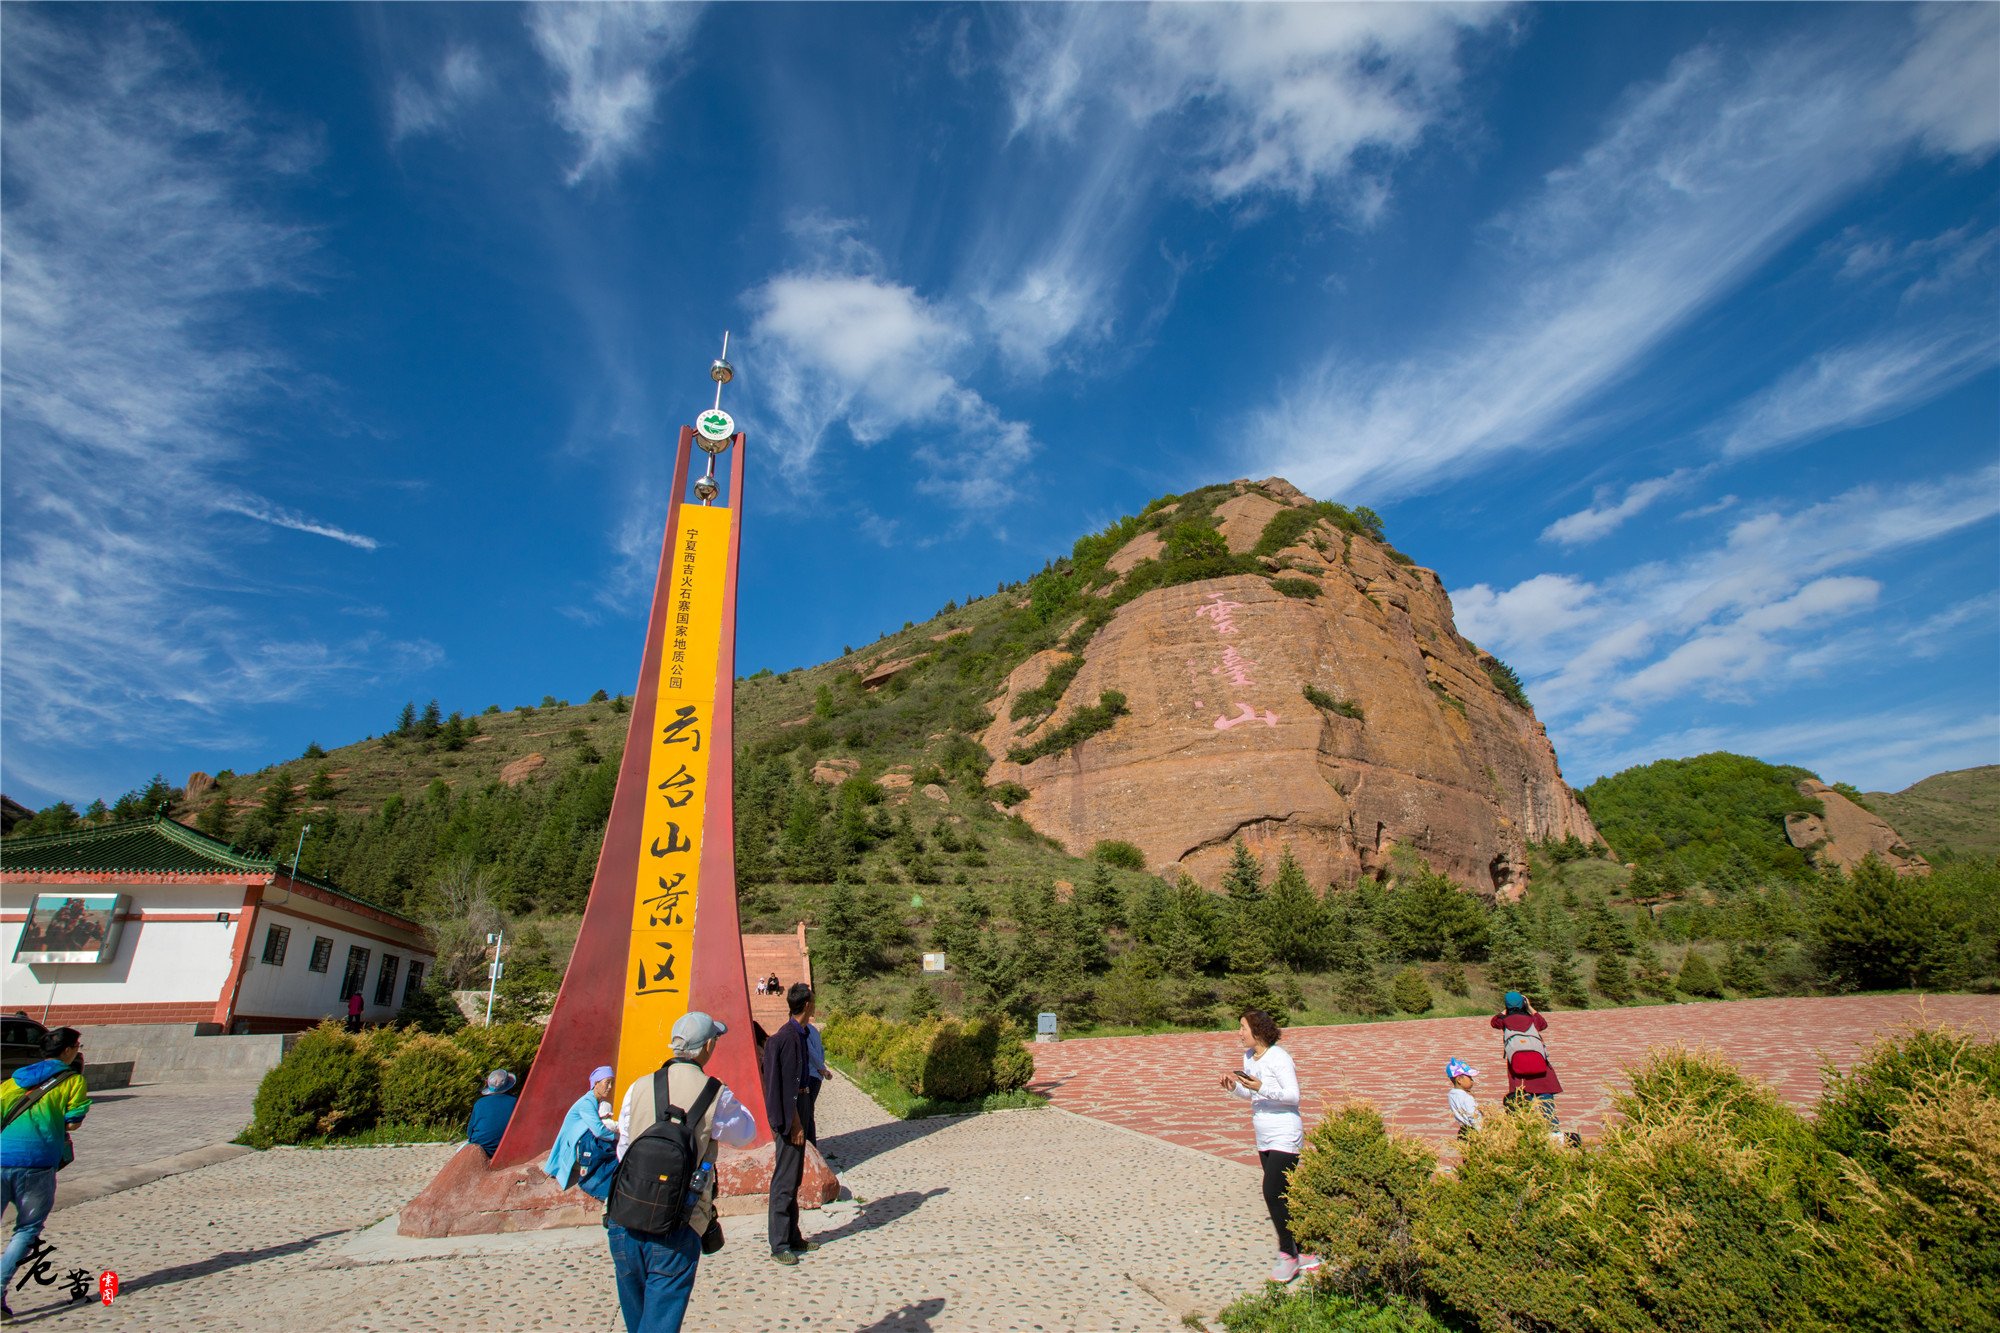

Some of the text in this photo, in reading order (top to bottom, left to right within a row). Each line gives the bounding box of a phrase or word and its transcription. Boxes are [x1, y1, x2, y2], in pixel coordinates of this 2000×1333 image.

[669, 528, 699, 689] 宁夏西吉火石寨国家地质公园
[635, 705, 700, 996] 云台山景区
